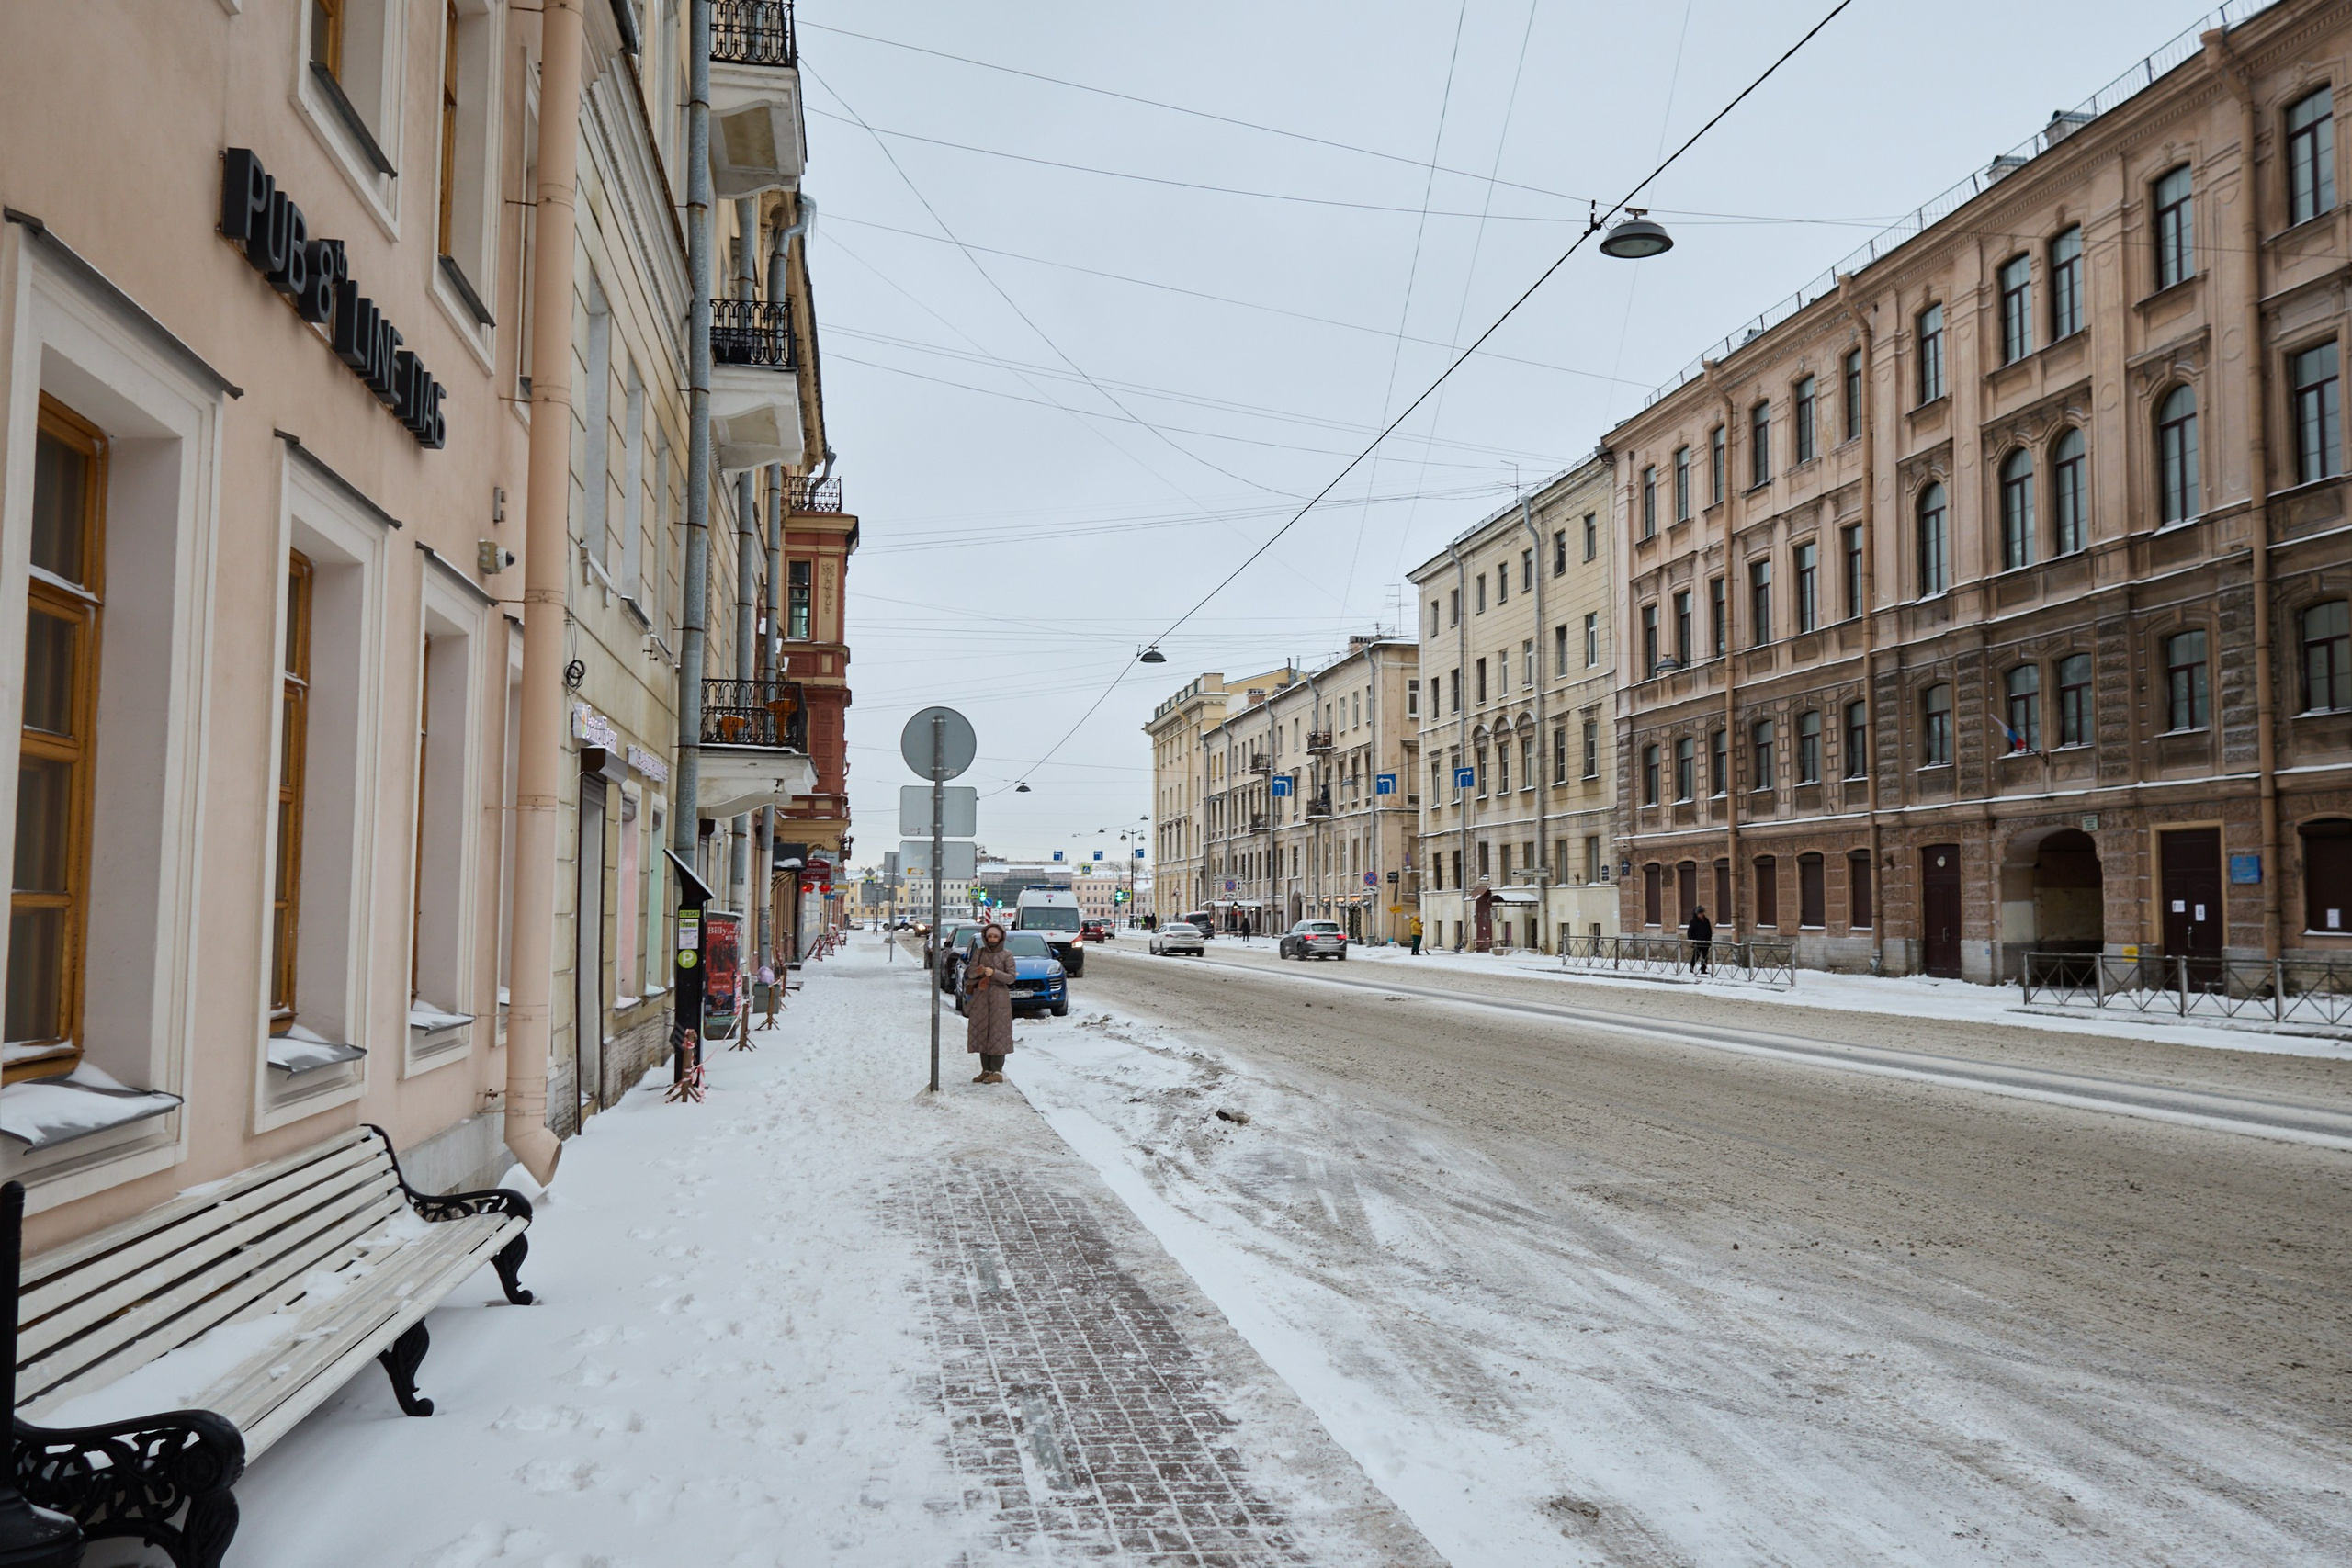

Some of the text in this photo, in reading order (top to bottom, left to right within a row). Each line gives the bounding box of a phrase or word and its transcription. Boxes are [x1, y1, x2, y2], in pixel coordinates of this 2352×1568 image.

[223, 148, 308, 294] PUB
[334, 280, 403, 405] LINE
[682, 952, 694, 965] P
